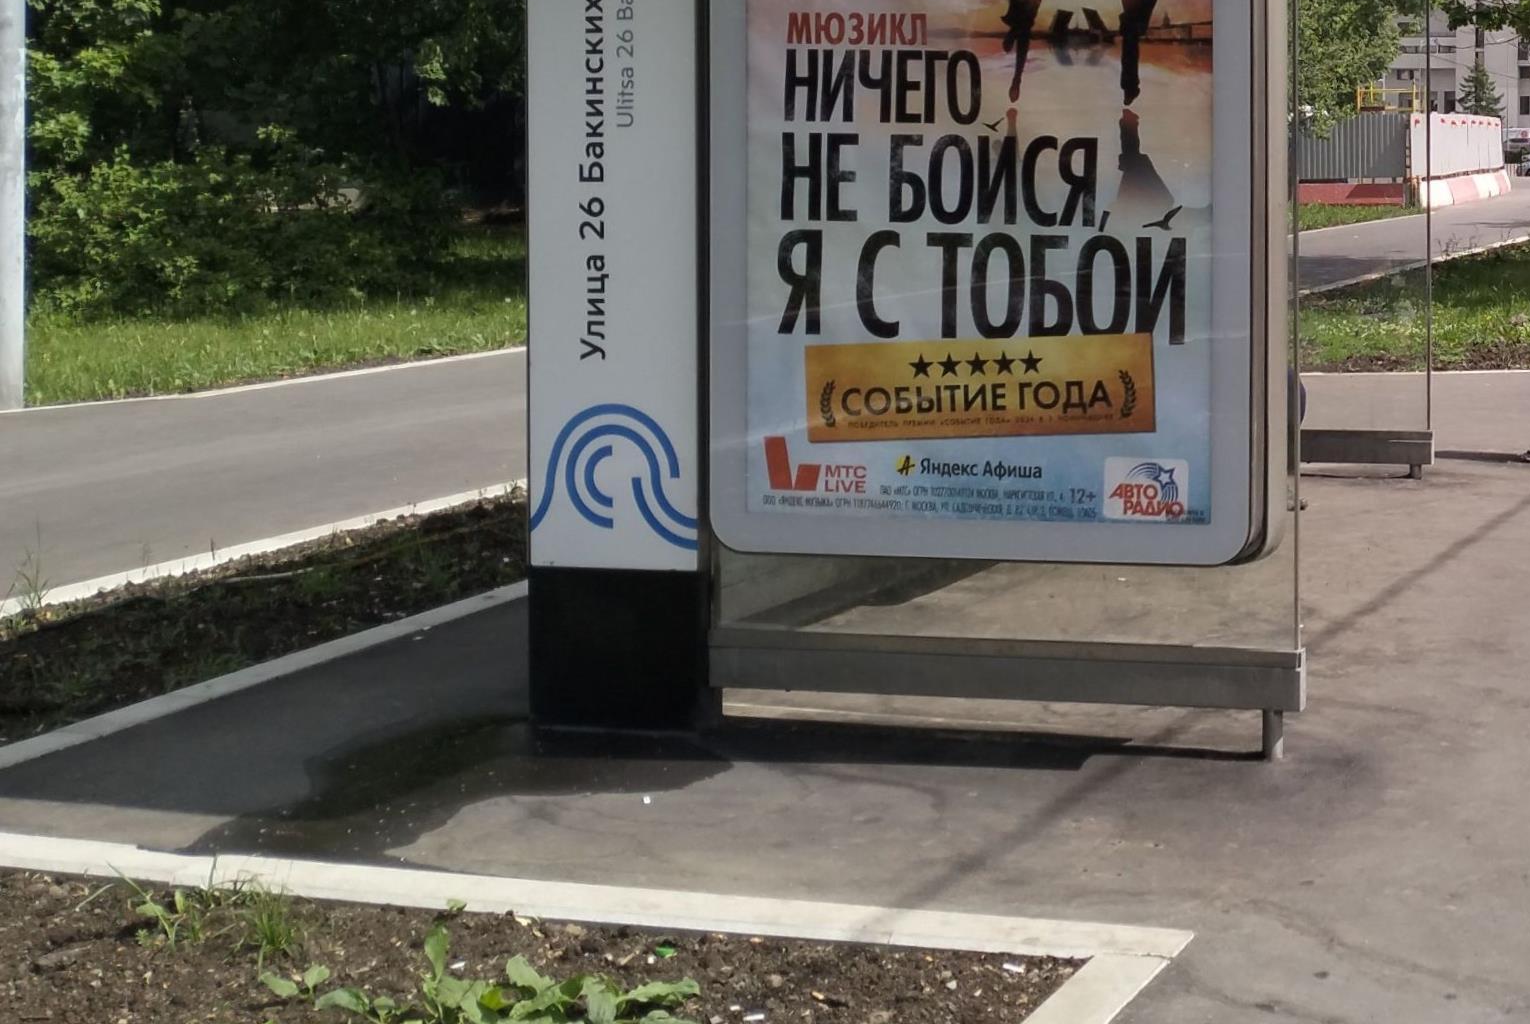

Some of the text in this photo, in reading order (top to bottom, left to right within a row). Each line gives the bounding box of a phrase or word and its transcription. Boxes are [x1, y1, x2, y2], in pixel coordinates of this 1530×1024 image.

[615, 30, 635, 59] 26
[787, 12, 927, 46] МЮЗИКЛ
[614, 66, 636, 128] Ulitsa
[783, 48, 983, 125] НИЧЕГО
[780, 132, 1111, 233] НЕ БОЙСЯ,
[579, 196, 605, 241] 26
[776, 228, 1188, 346] Я С ТОБОЙ
[579, 254, 608, 362] Улица
[840, 378, 1114, 417] СОБЫТИЕ ГОДА
[824, 464, 868, 479] МТС
[920, 457, 1043, 480] Яндекс Афиша
[824, 479, 867, 494] LIVE
[1069, 487, 1098, 504] 12+
[1108, 484, 1158, 501] АВТО
[1122, 499, 1184, 519] РАДИО
